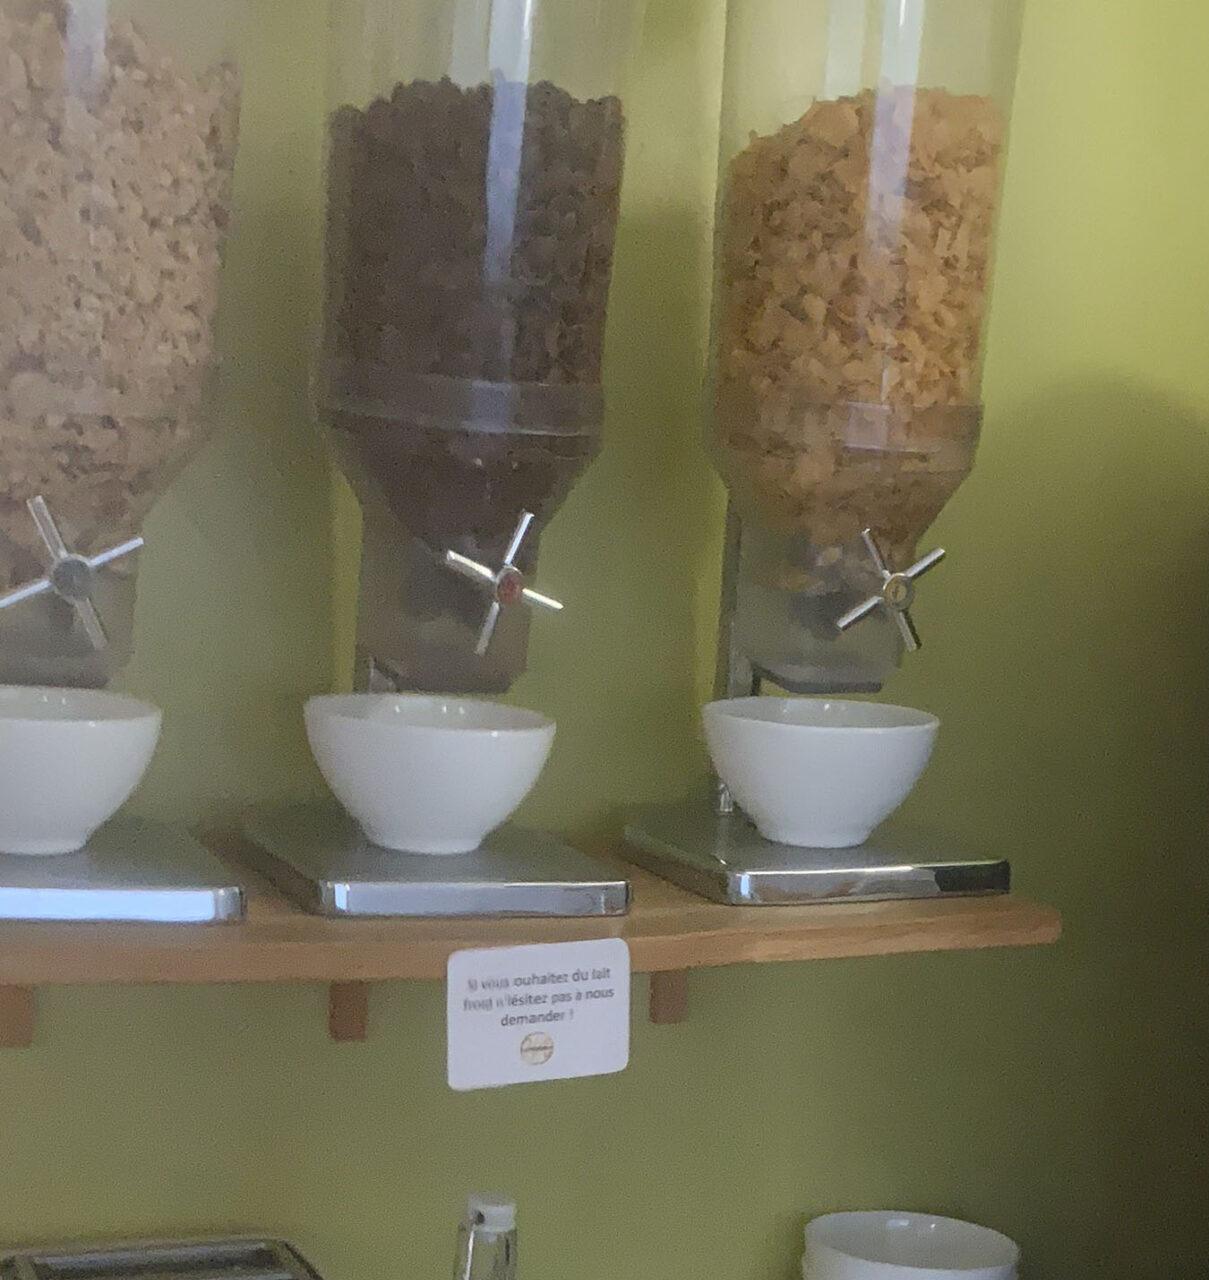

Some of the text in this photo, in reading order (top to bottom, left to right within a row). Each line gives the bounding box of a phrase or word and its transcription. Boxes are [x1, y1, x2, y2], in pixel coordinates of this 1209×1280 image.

[513, 972, 569, 987] ouhaitez
[571, 969, 589, 982] du
[591, 967, 611, 980] lait
[551, 991, 573, 1004] pas
[585, 987, 615, 1000] nous
[500, 1010, 565, 1027] demander
